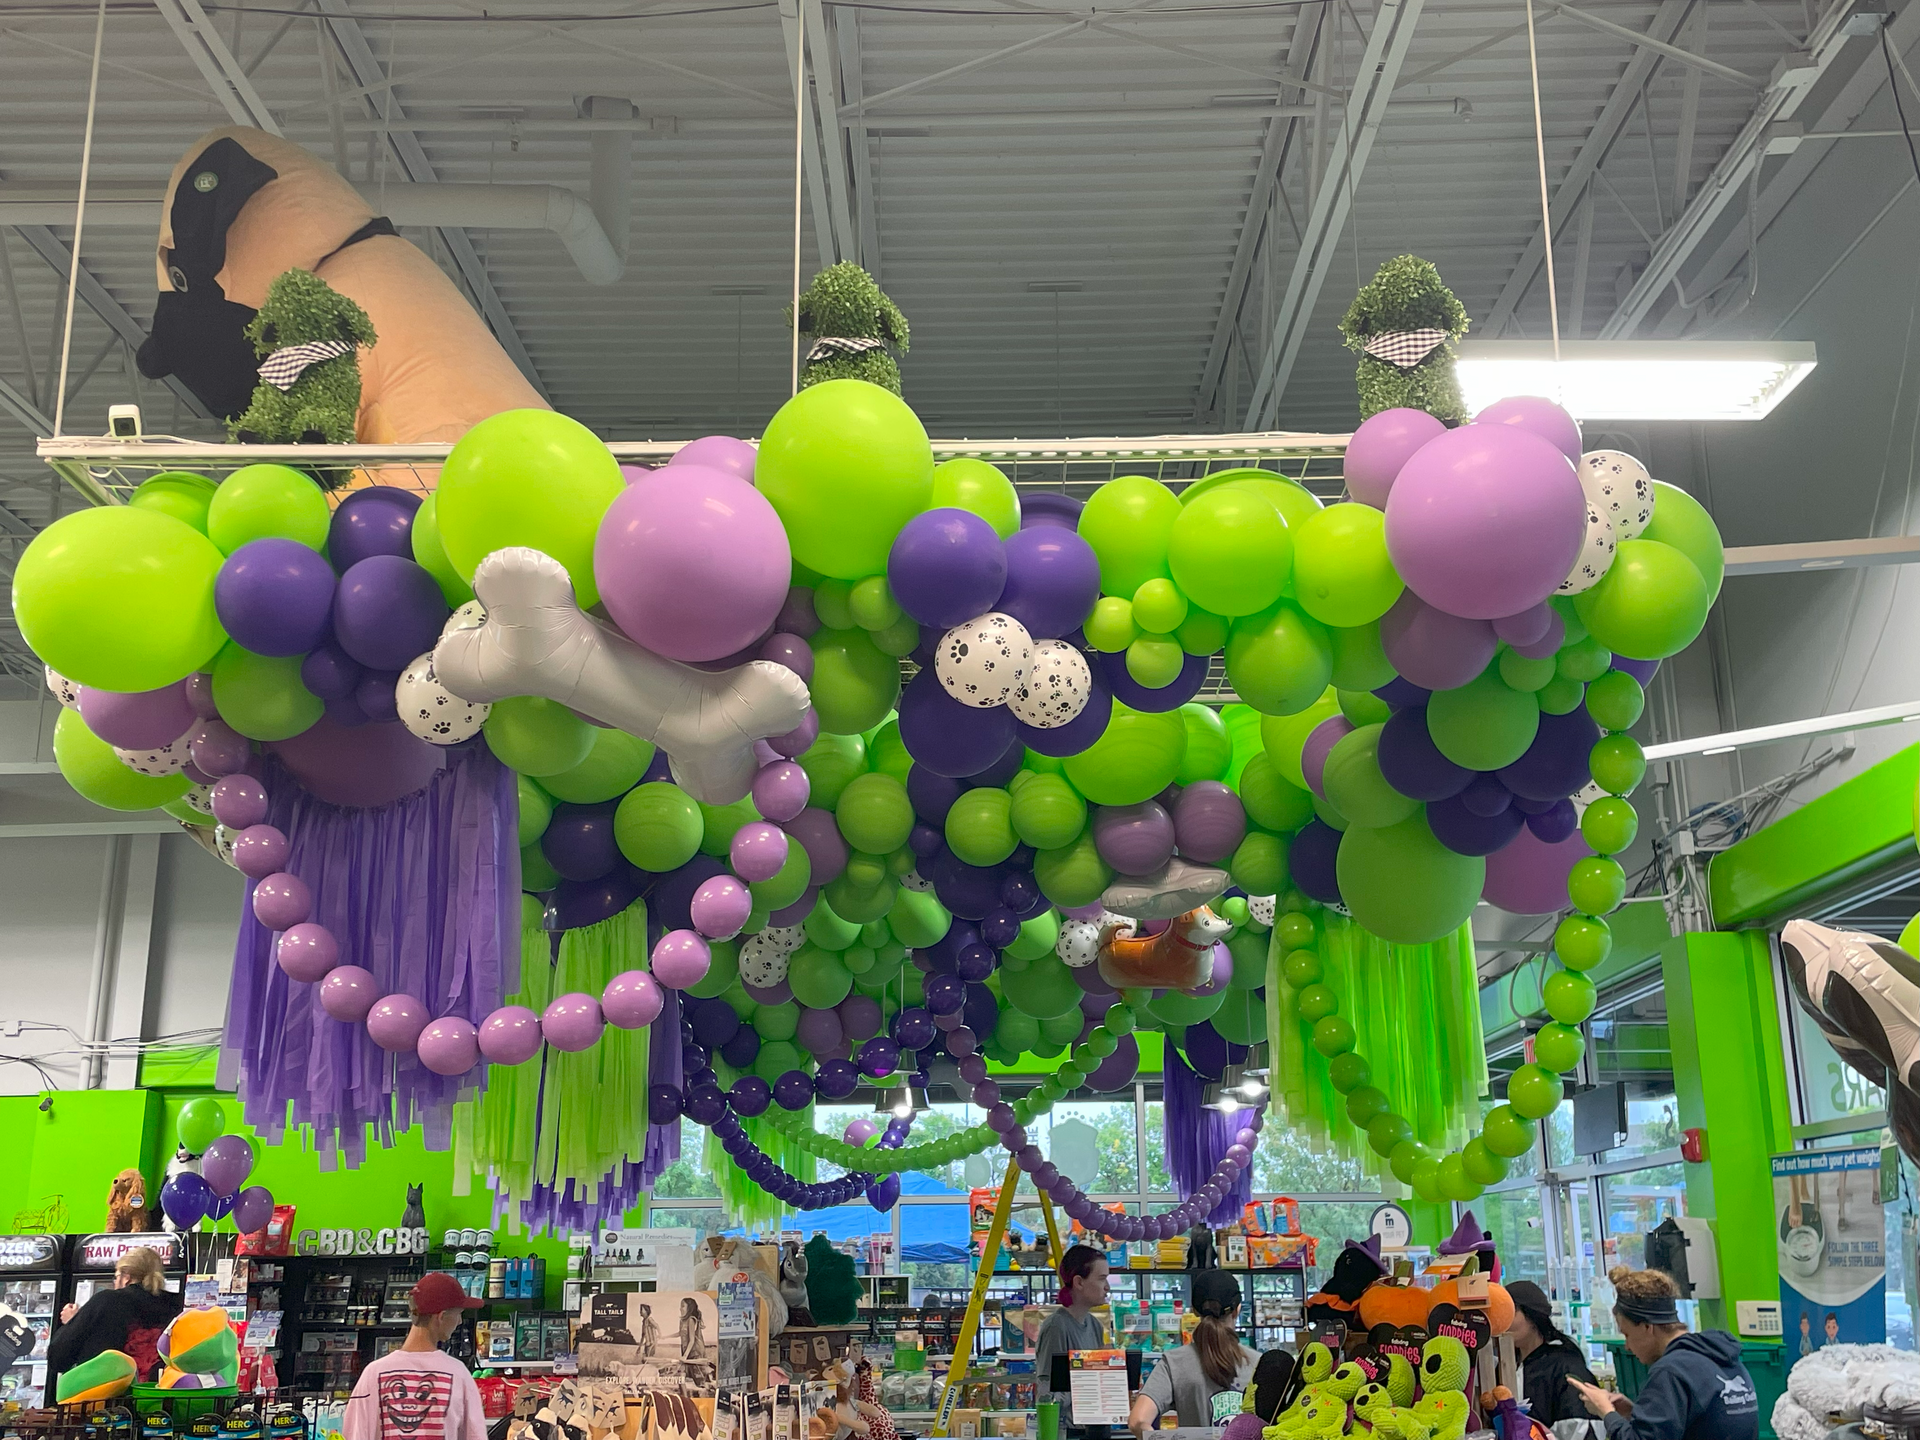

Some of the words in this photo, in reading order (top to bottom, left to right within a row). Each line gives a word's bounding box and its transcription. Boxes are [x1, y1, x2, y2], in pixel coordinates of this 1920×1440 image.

[1772, 1158, 1785, 1171] Find
[1786, 1158, 1796, 1170] out
[1797, 1157, 1810, 1169] how
[1811, 1154, 1827, 1168] much
[1829, 1155, 1843, 1169] your
[1844, 1151, 1855, 1168] pet
[85, 1246, 115, 1258] RAW
[1828, 1242, 1849, 1253] FOLLOW
[1851, 1242, 1860, 1252] THE
[1861, 1241, 1879, 1252] THREE
[0, 1256, 33, 1265] FOOD
[1849, 1256, 1863, 1267] STEPS
